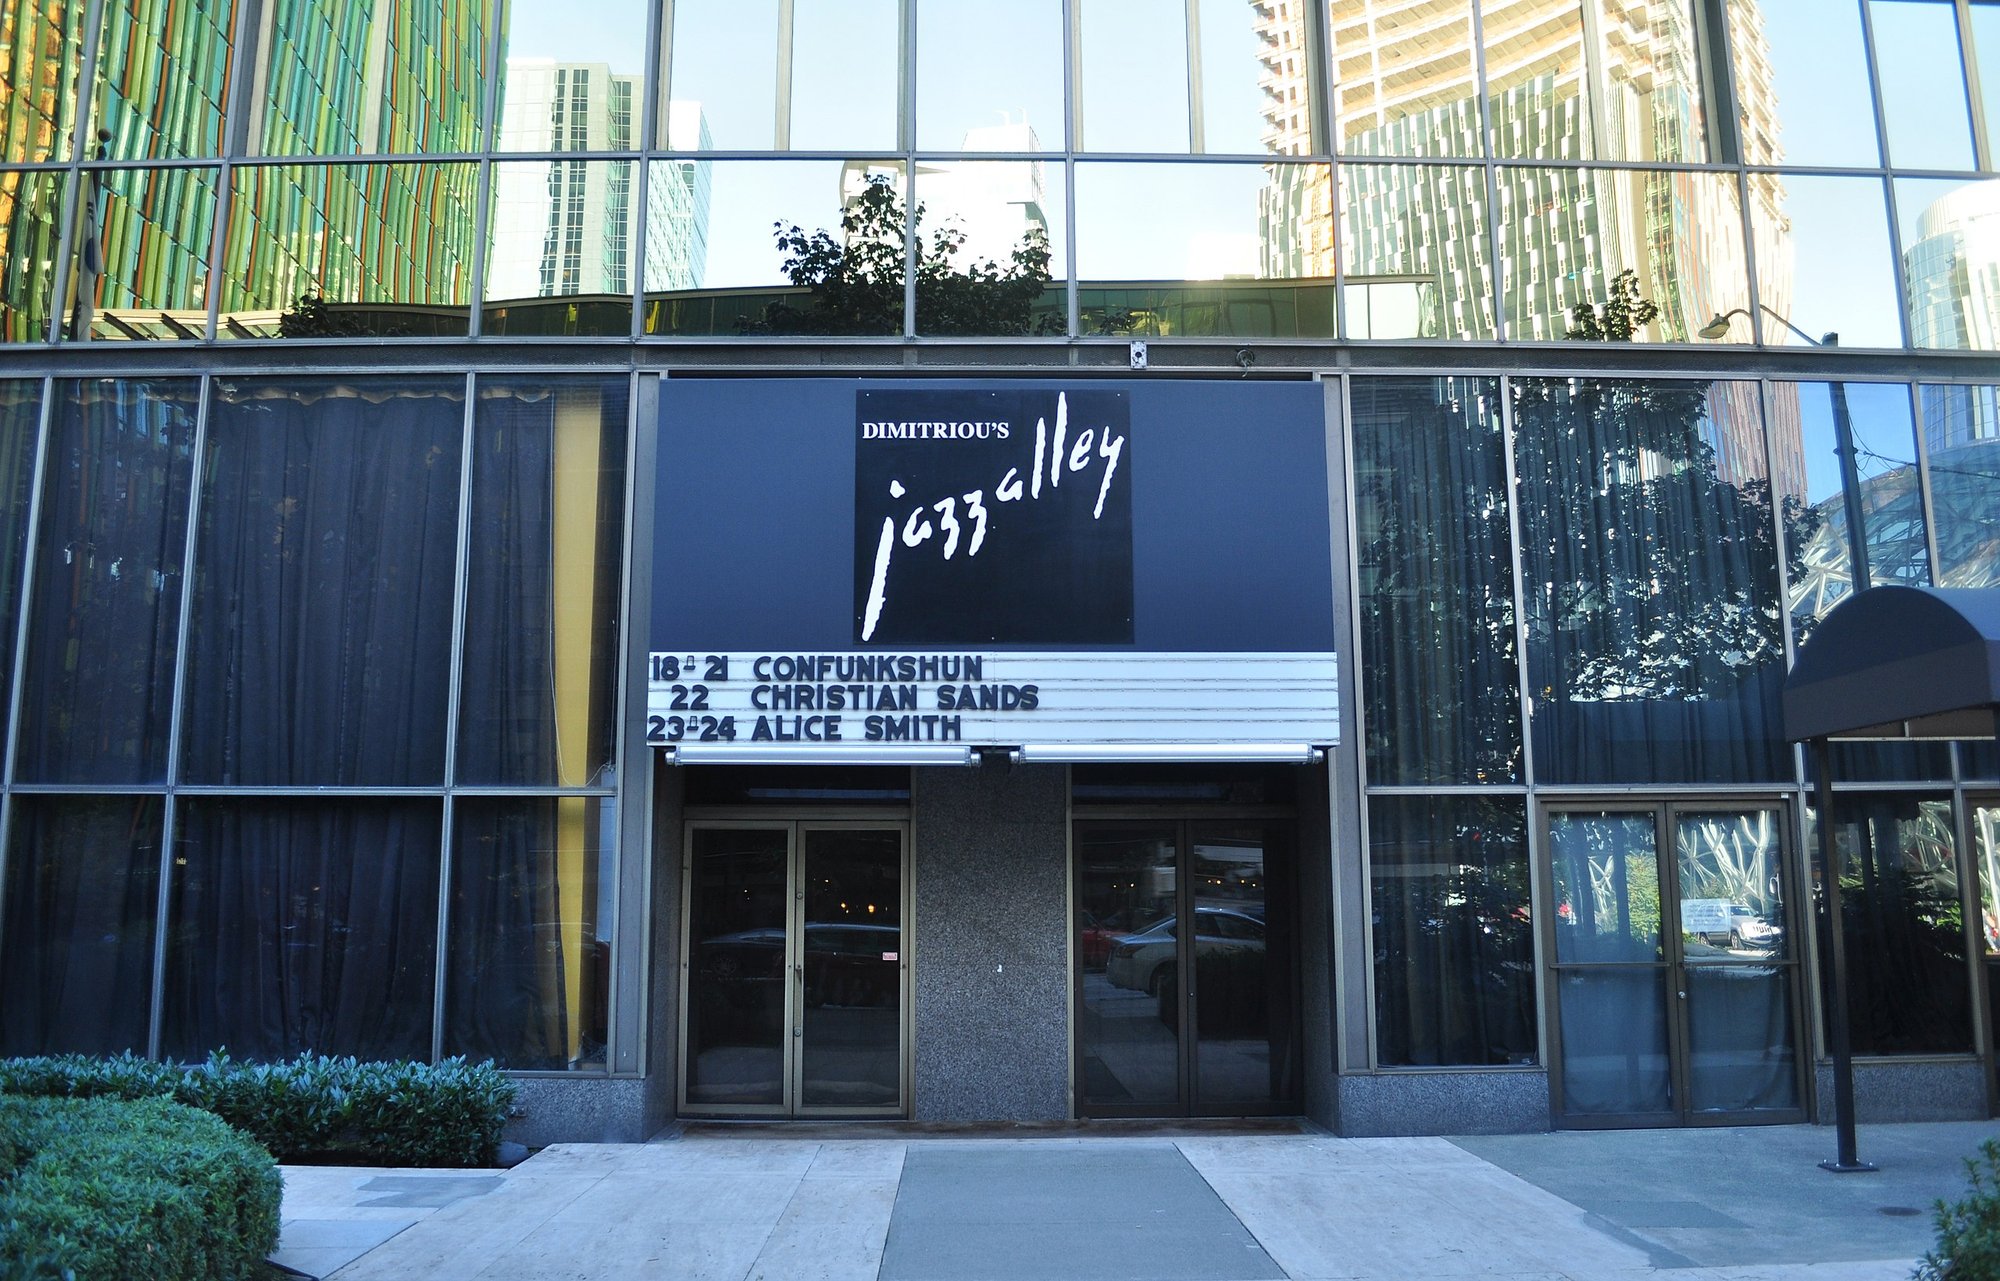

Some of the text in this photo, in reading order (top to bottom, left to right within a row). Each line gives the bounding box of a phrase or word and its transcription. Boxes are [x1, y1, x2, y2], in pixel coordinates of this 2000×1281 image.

[862, 422, 1009, 439] DIMITRIOU'S
[862, 391, 1124, 641] jazz alley
[753, 655, 982, 681] CONFUNKSHUN
[670, 684, 1039, 710] 22 CHRISTIAN SANDS
[751, 715, 841, 740] ALICE
[865, 715, 961, 740] SMITH
